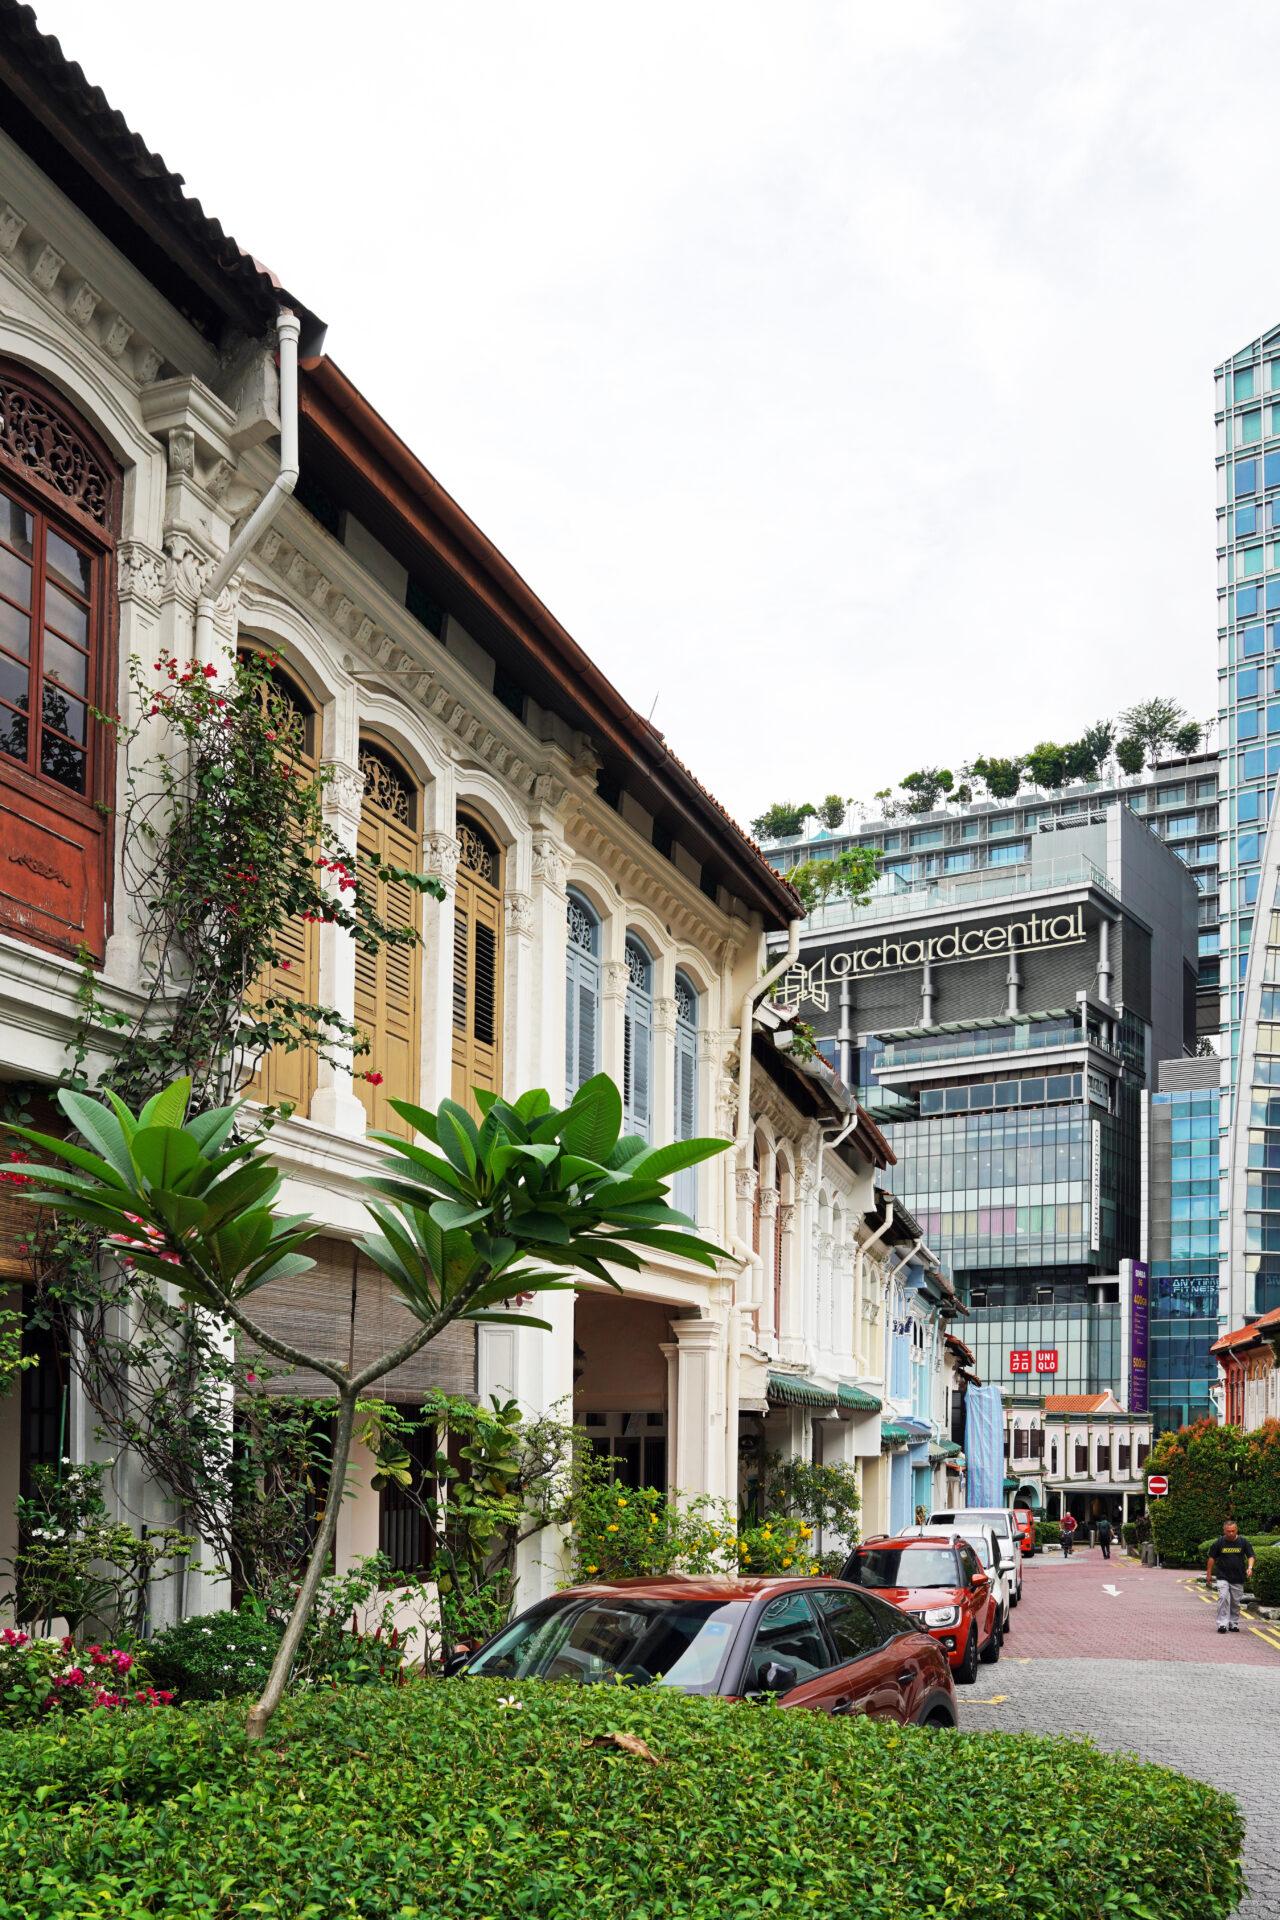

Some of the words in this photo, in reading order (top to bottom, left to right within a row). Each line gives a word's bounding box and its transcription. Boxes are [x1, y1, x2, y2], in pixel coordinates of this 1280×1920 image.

[830, 905, 1087, 976] orchardcentral
[1038, 1353, 1054, 1361] UNI
[1038, 1362, 1055, 1371] QLO
